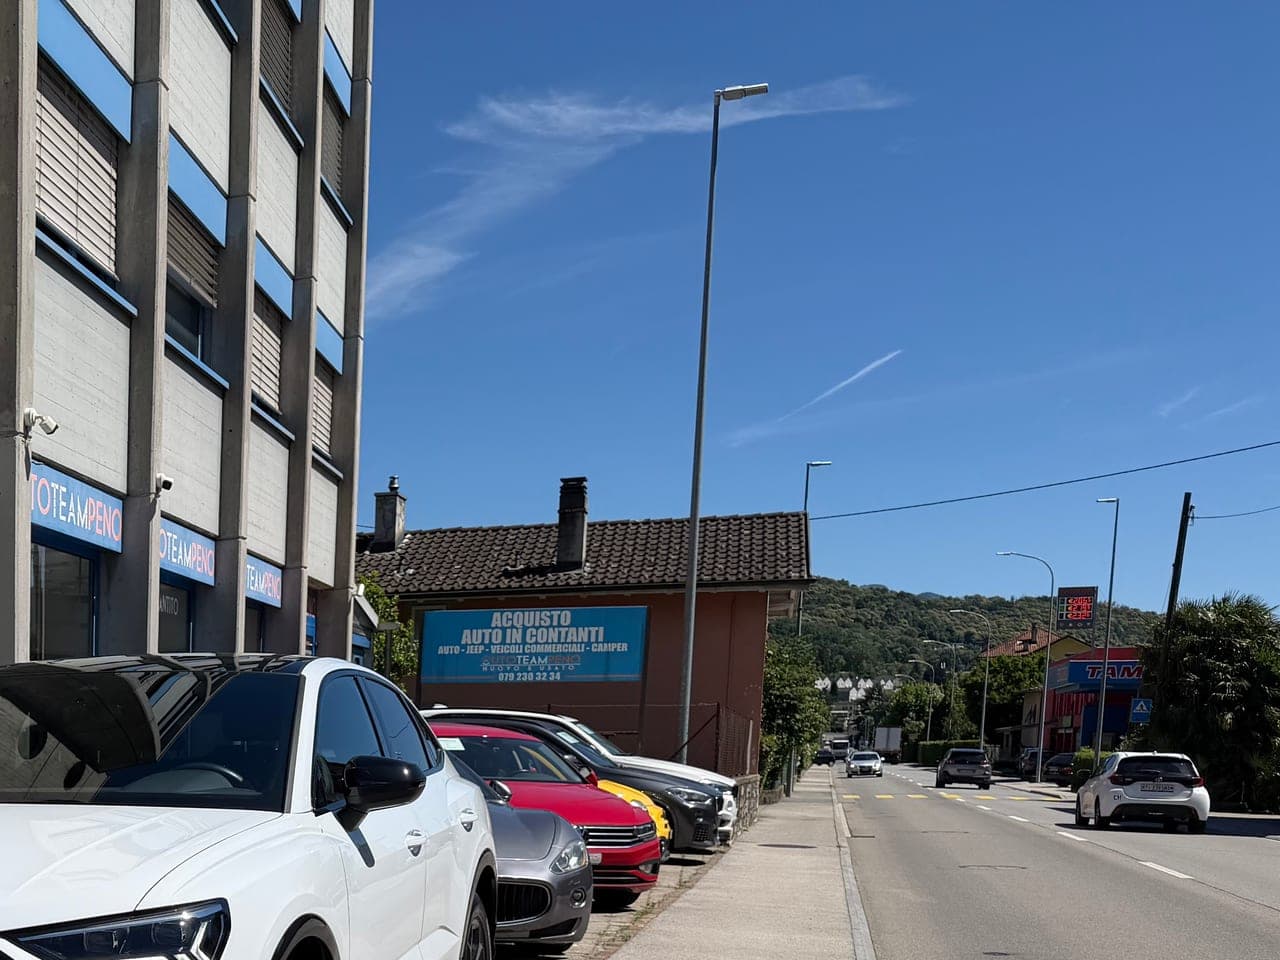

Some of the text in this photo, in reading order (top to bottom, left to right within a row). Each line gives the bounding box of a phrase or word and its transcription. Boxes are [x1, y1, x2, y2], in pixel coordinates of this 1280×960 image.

[491, 610, 571, 628] ACQUISTO
[461, 626, 604, 645] AUTO IN CONTANTI
[438, 642, 628, 655] AUTO JEEP VEICOLI COMMERCIALI CAMPER
[498, 671, 561, 681] 079 230 32 34
